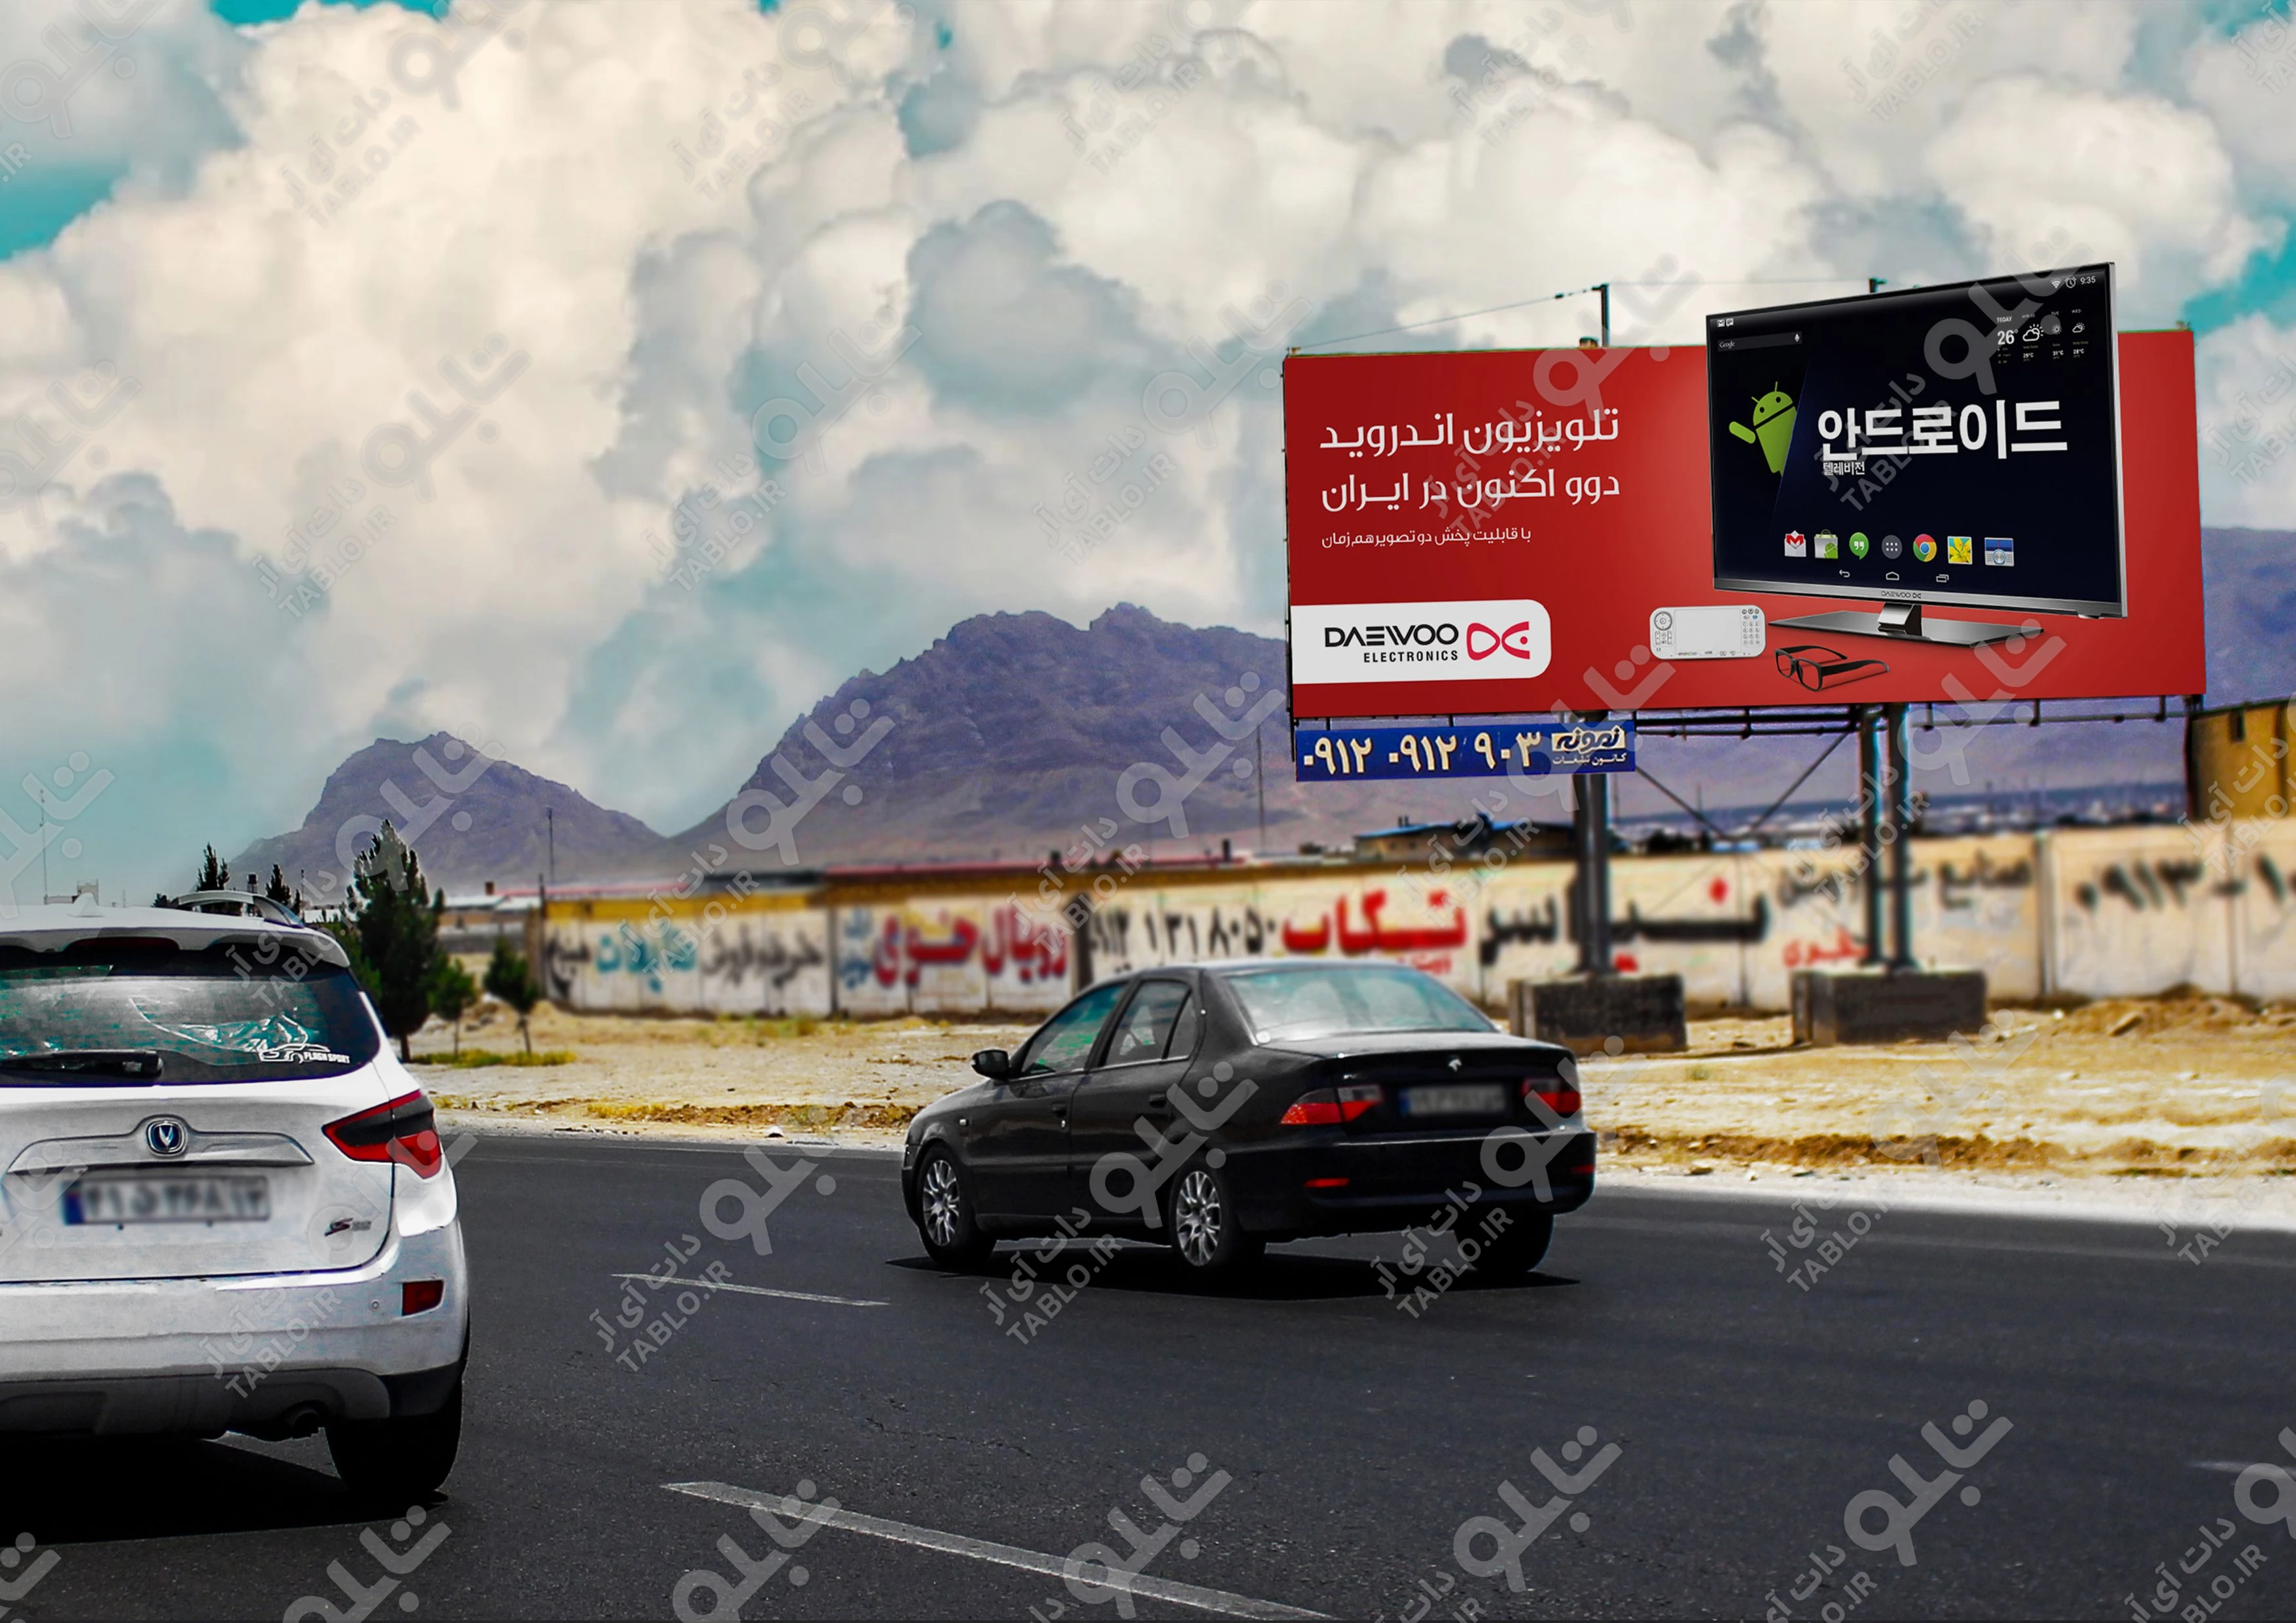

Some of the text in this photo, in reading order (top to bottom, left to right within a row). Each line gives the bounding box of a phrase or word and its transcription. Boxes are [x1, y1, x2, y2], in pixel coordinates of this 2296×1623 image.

[2080, 276, 2096, 285] 9:35
[1320, 408, 1619, 457] تلویزیون اندروید
[1818, 400, 2068, 461] 안드로이드
[1823, 461, 1865, 476] 텔레비전
[1322, 469, 1620, 512] دوو اکنون در ایران
[1417, 533, 1431, 546] دو
[1435, 527, 1470, 547] پخش
[1473, 527, 1518, 544] قابلیت
[1521, 527, 1531, 543] با
[1325, 624, 1458, 647] DAEWOO
[1363, 650, 1458, 663] ELECTRONICS
